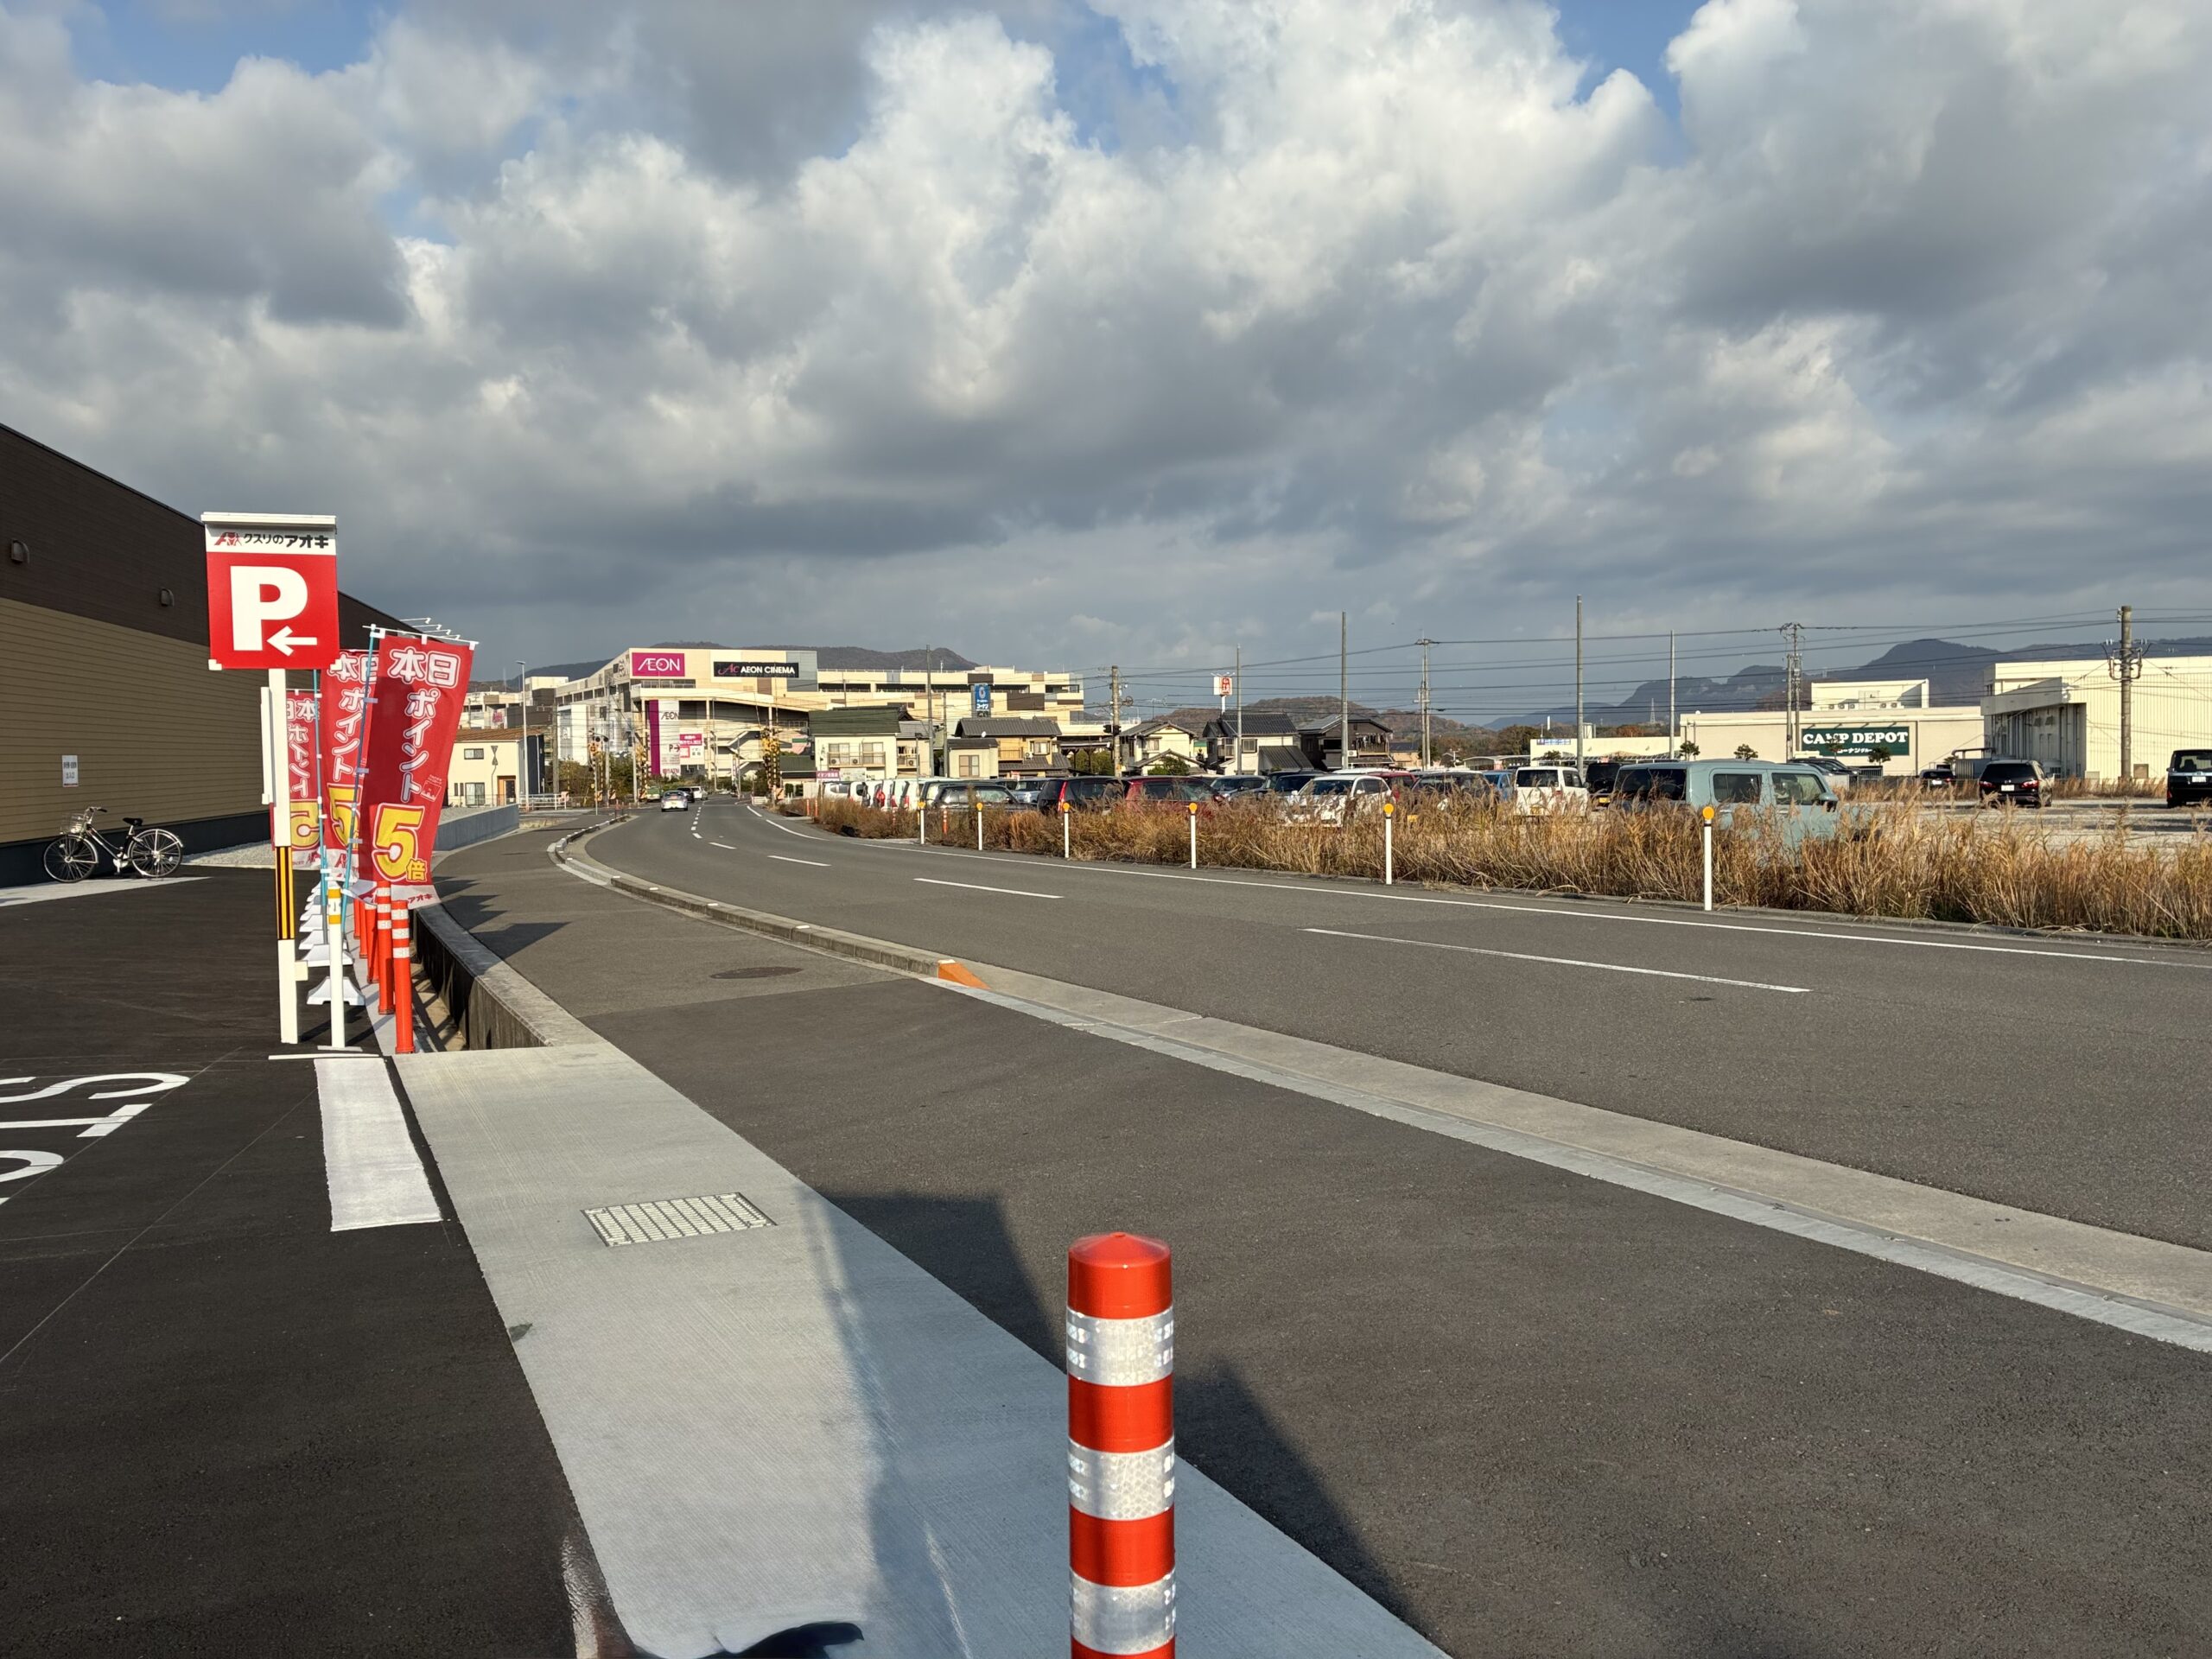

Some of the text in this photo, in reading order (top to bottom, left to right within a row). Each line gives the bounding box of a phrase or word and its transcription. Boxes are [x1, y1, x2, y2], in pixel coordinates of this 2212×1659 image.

[244, 533, 329, 549] クスリのアオキ
[230, 565, 308, 651] P
[389, 647, 461, 688] 本日
[399, 689, 441, 803] ポイント
[1853, 732, 1908, 743] DEPOT
